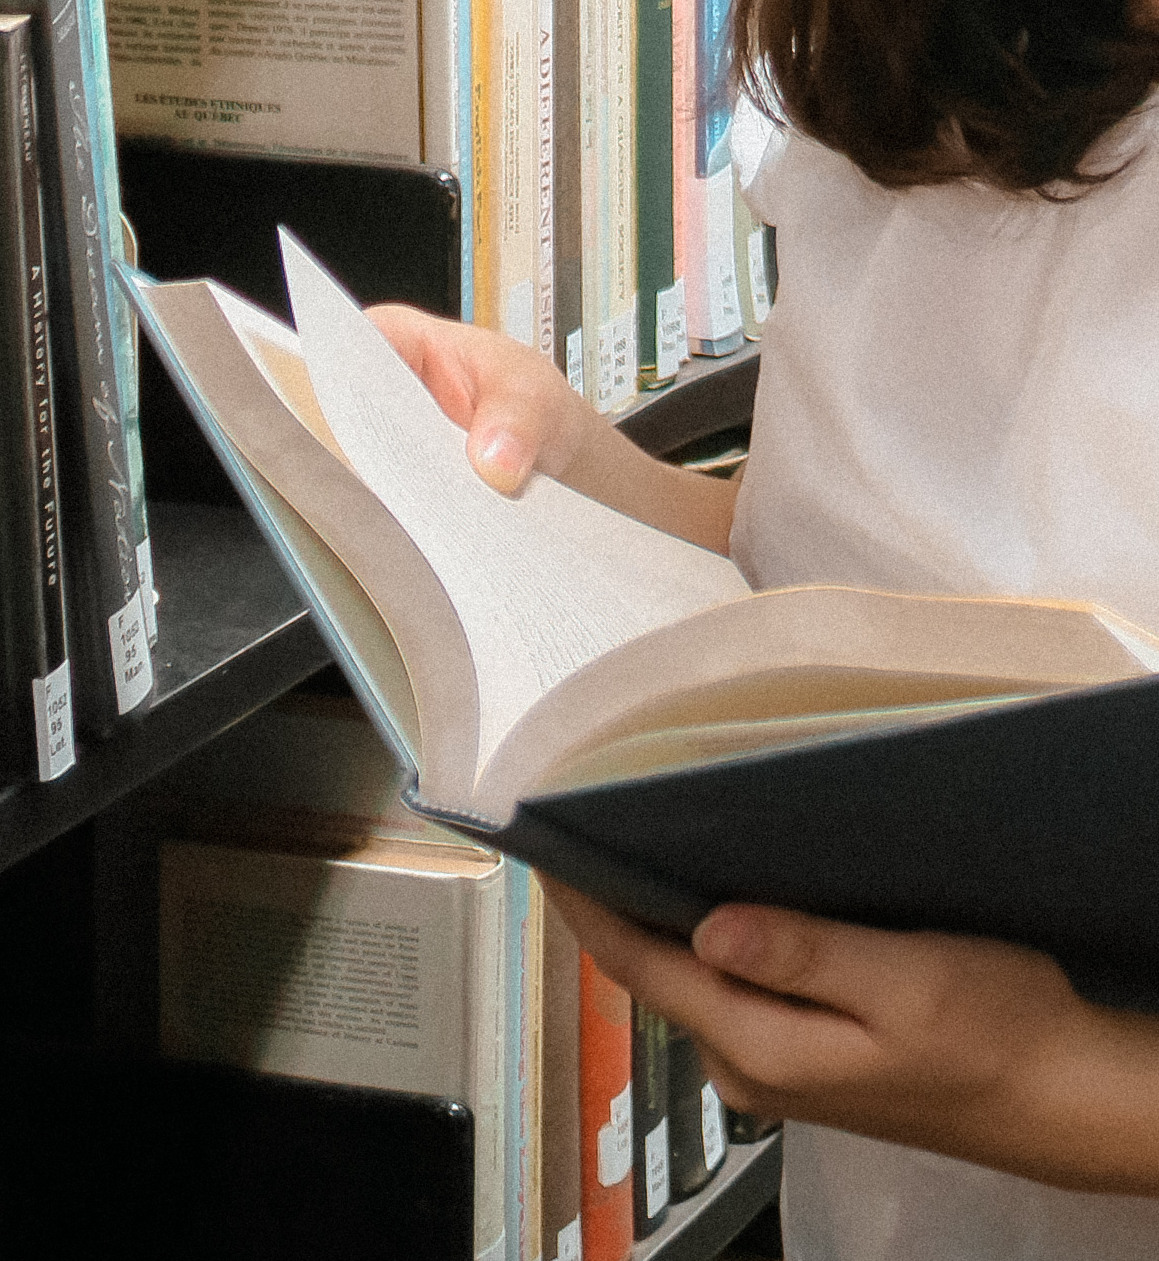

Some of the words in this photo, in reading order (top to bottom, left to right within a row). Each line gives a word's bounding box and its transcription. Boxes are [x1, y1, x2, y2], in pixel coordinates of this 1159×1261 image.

[540, 28, 551, 48] A
[539, 56, 552, 249] DIFFERENT
[539, 257, 551, 352] VISIO
[118, 614, 125, 629] F
[125, 643, 137, 663] 95
[51, 716, 63, 736] 95
